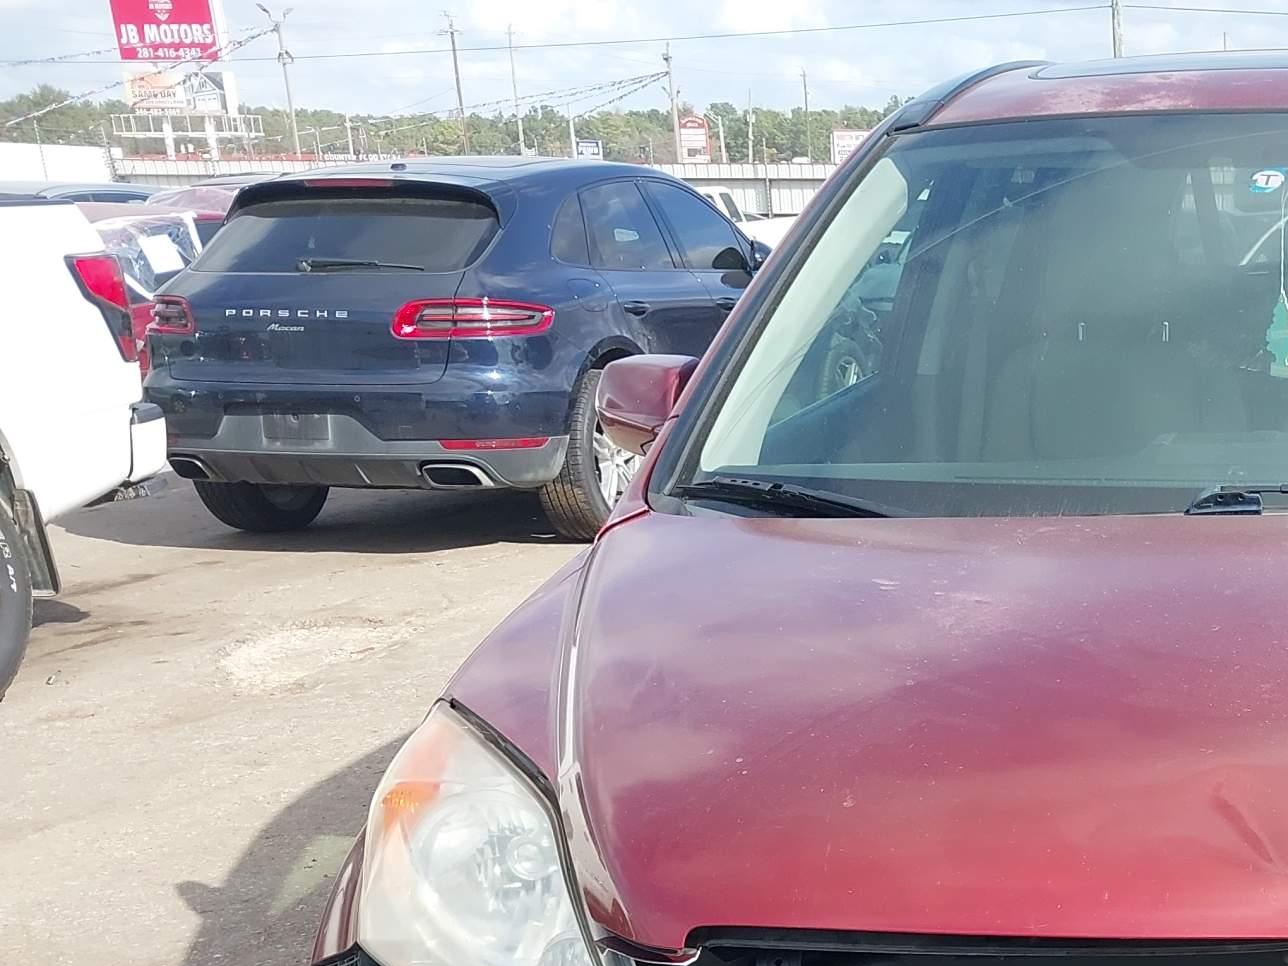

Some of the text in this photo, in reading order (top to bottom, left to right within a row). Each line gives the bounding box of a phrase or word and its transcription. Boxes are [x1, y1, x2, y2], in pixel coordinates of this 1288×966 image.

[120, 24, 213, 44] JB MOTORS
[225, 308, 348, 318] PORSCHE
[266, 323, 305, 331] Macan
